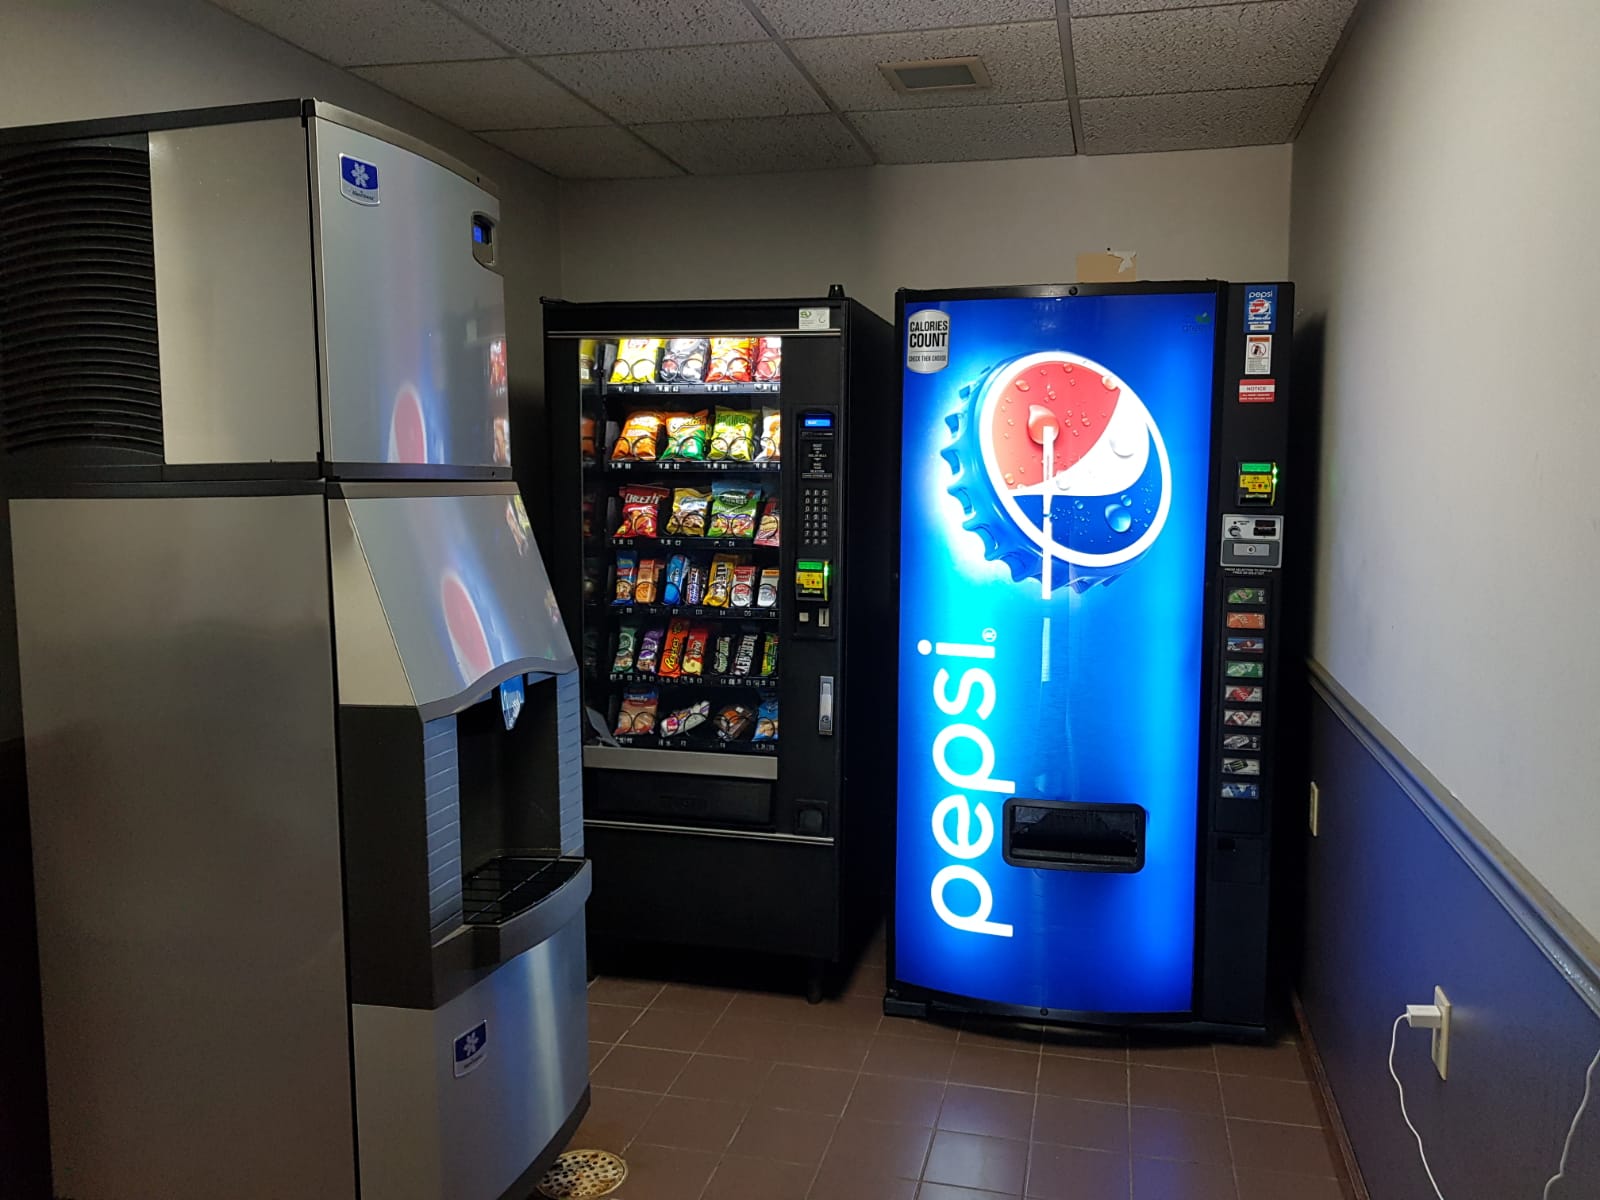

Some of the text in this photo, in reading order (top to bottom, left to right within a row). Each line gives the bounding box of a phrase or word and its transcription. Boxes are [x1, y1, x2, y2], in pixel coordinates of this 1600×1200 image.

[1248, 290, 1273, 300] pepsi
[910, 320, 949, 332] CALORIES
[910, 332, 948, 348] COUNT
[917, 638, 1016, 937] pepsi
